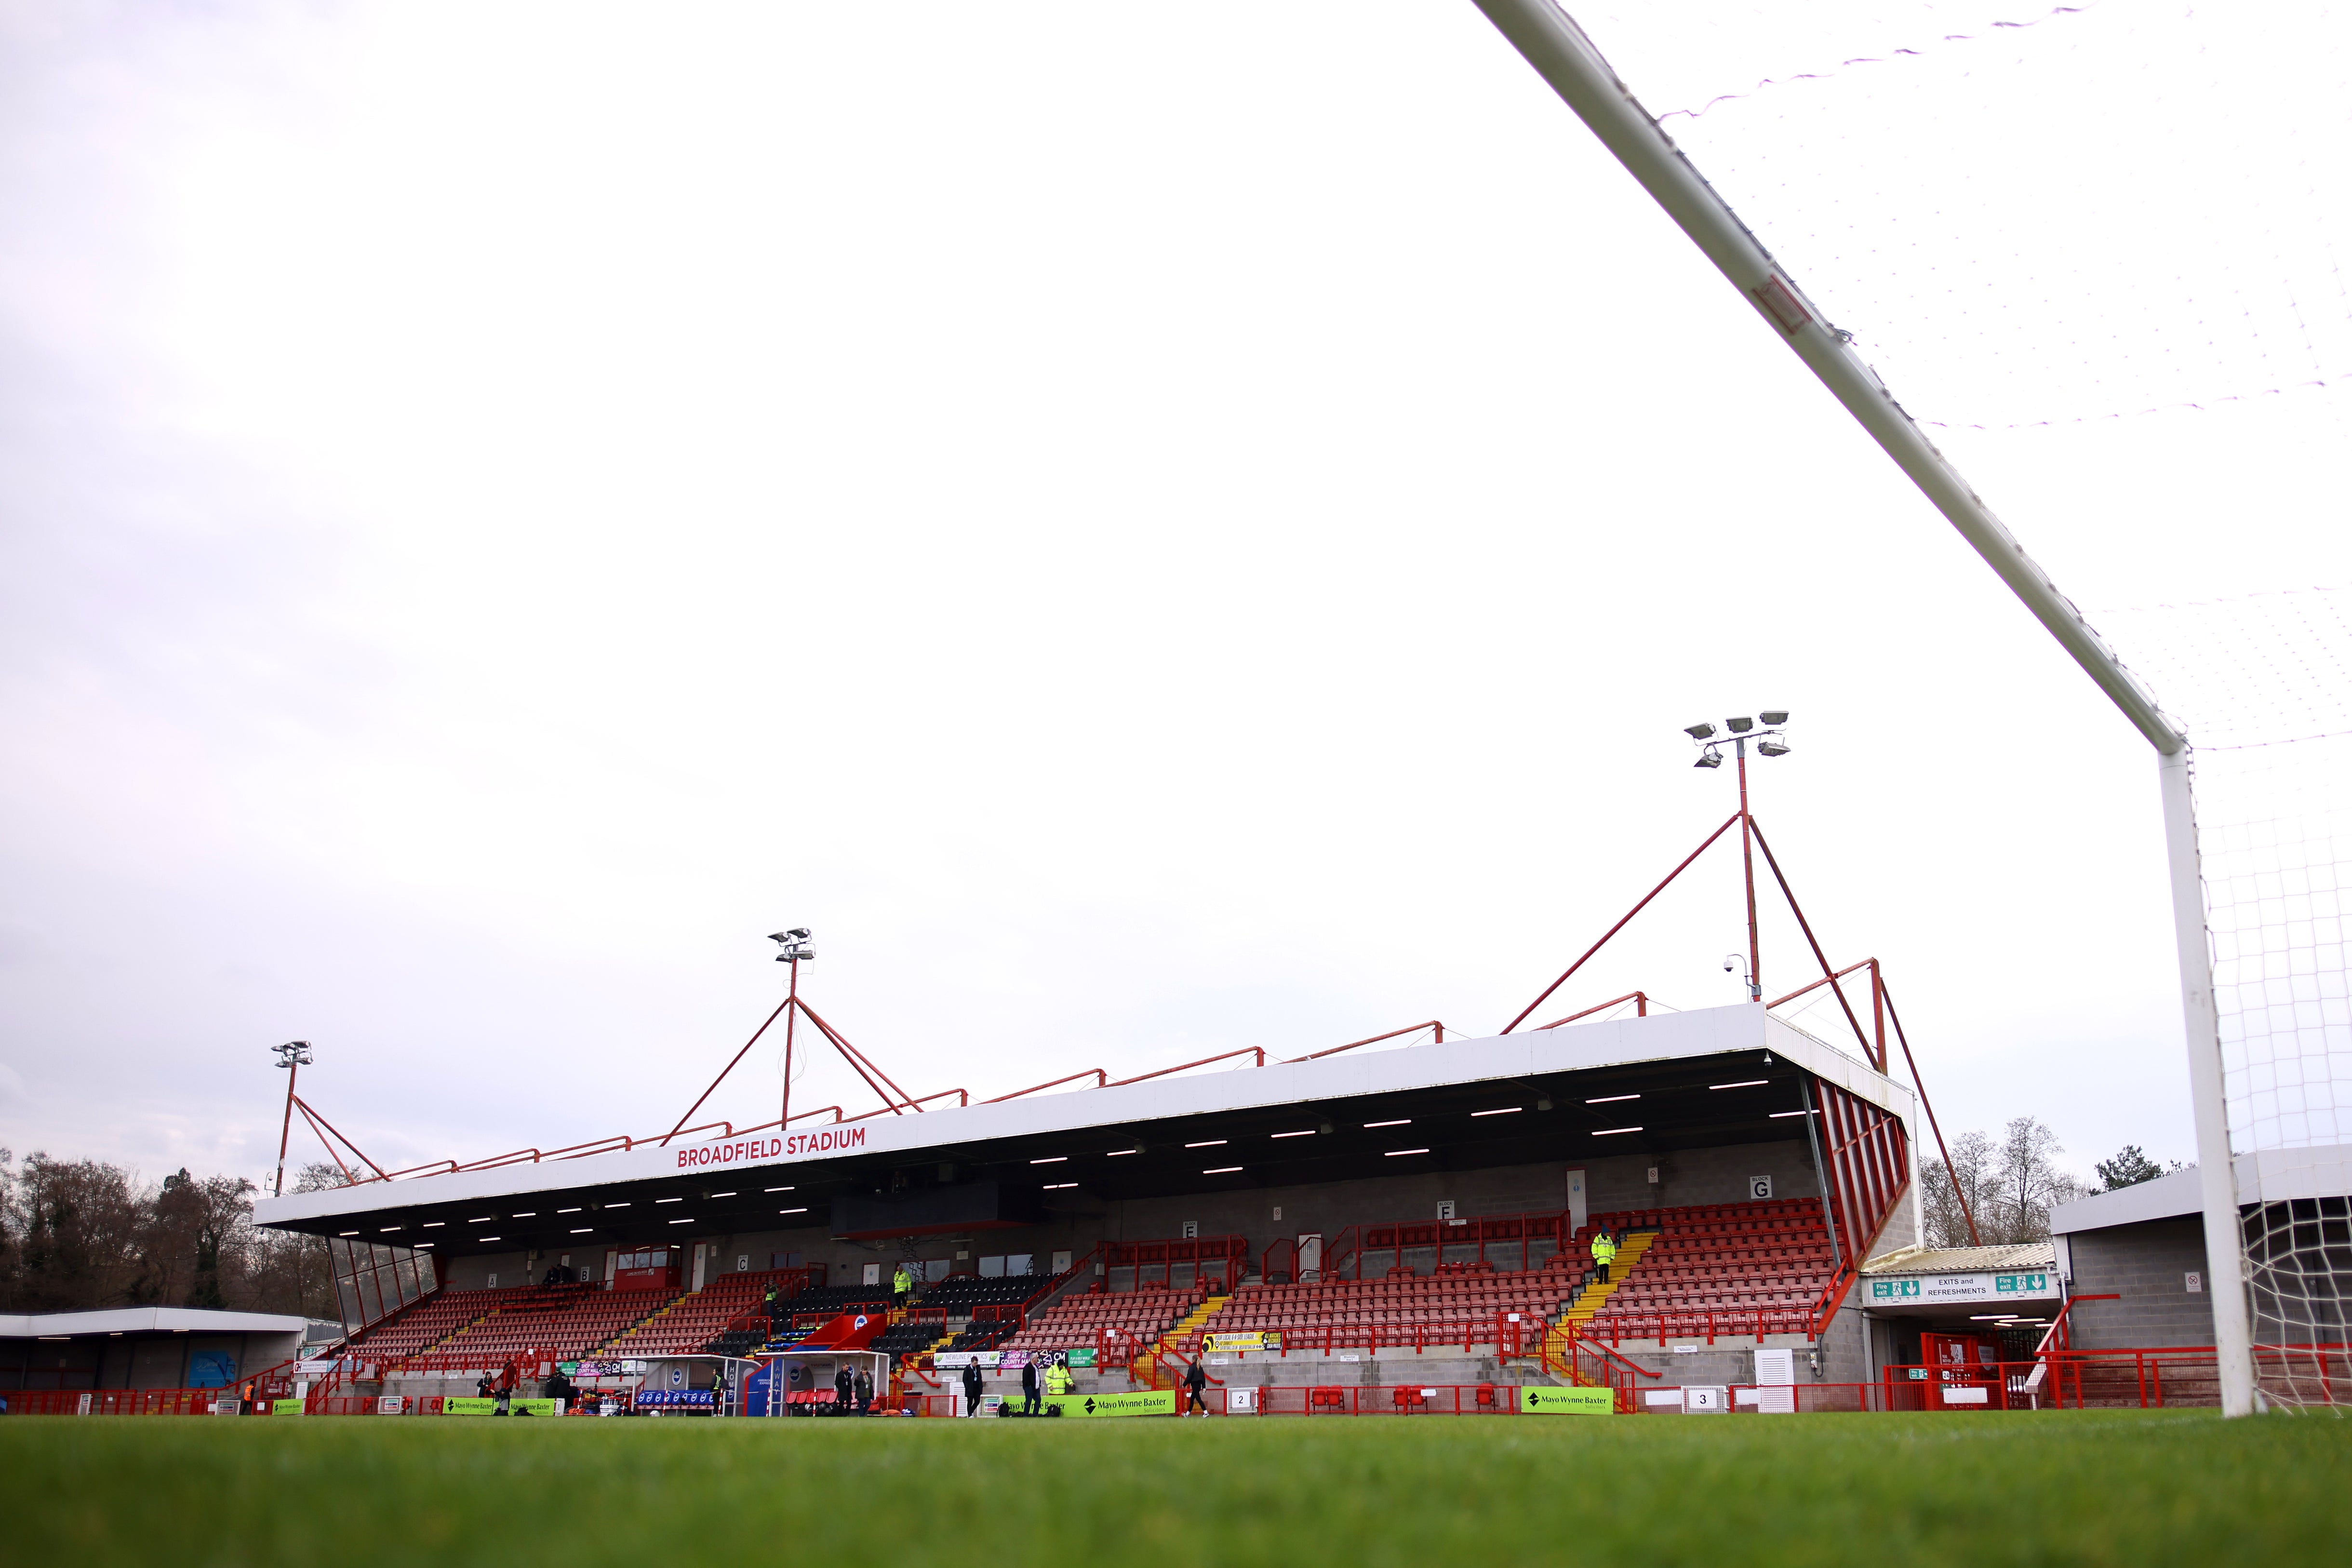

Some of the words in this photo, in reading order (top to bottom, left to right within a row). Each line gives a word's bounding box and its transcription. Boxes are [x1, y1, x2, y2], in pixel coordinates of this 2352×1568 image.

[678, 1139, 781, 1167] BROADFIELD
[788, 1127, 865, 1154] STADIUM
[1754, 1181, 1767, 1197] G
[1442, 1206, 1450, 1219] F
[1187, 1226, 1194, 1238] E
[740, 1260, 745, 1270] C
[582, 1271, 587, 1280] B
[490, 1278, 494, 1287] A
[1928, 1287, 1986, 1296] REFRESHMENTS
[1054, 1352, 1065, 1361] CM
[1239, 1395, 1243, 1404] 2
[1541, 1396, 1559, 1405] Mayo
[1560, 1396, 1583, 1405] Wynne
[1700, 1394, 1706, 1404] 3
[1098, 1401, 1117, 1411] Mayo
[1118, 1400, 1142, 1410] Wynne
[1144, 1398, 1166, 1406] Baxter
